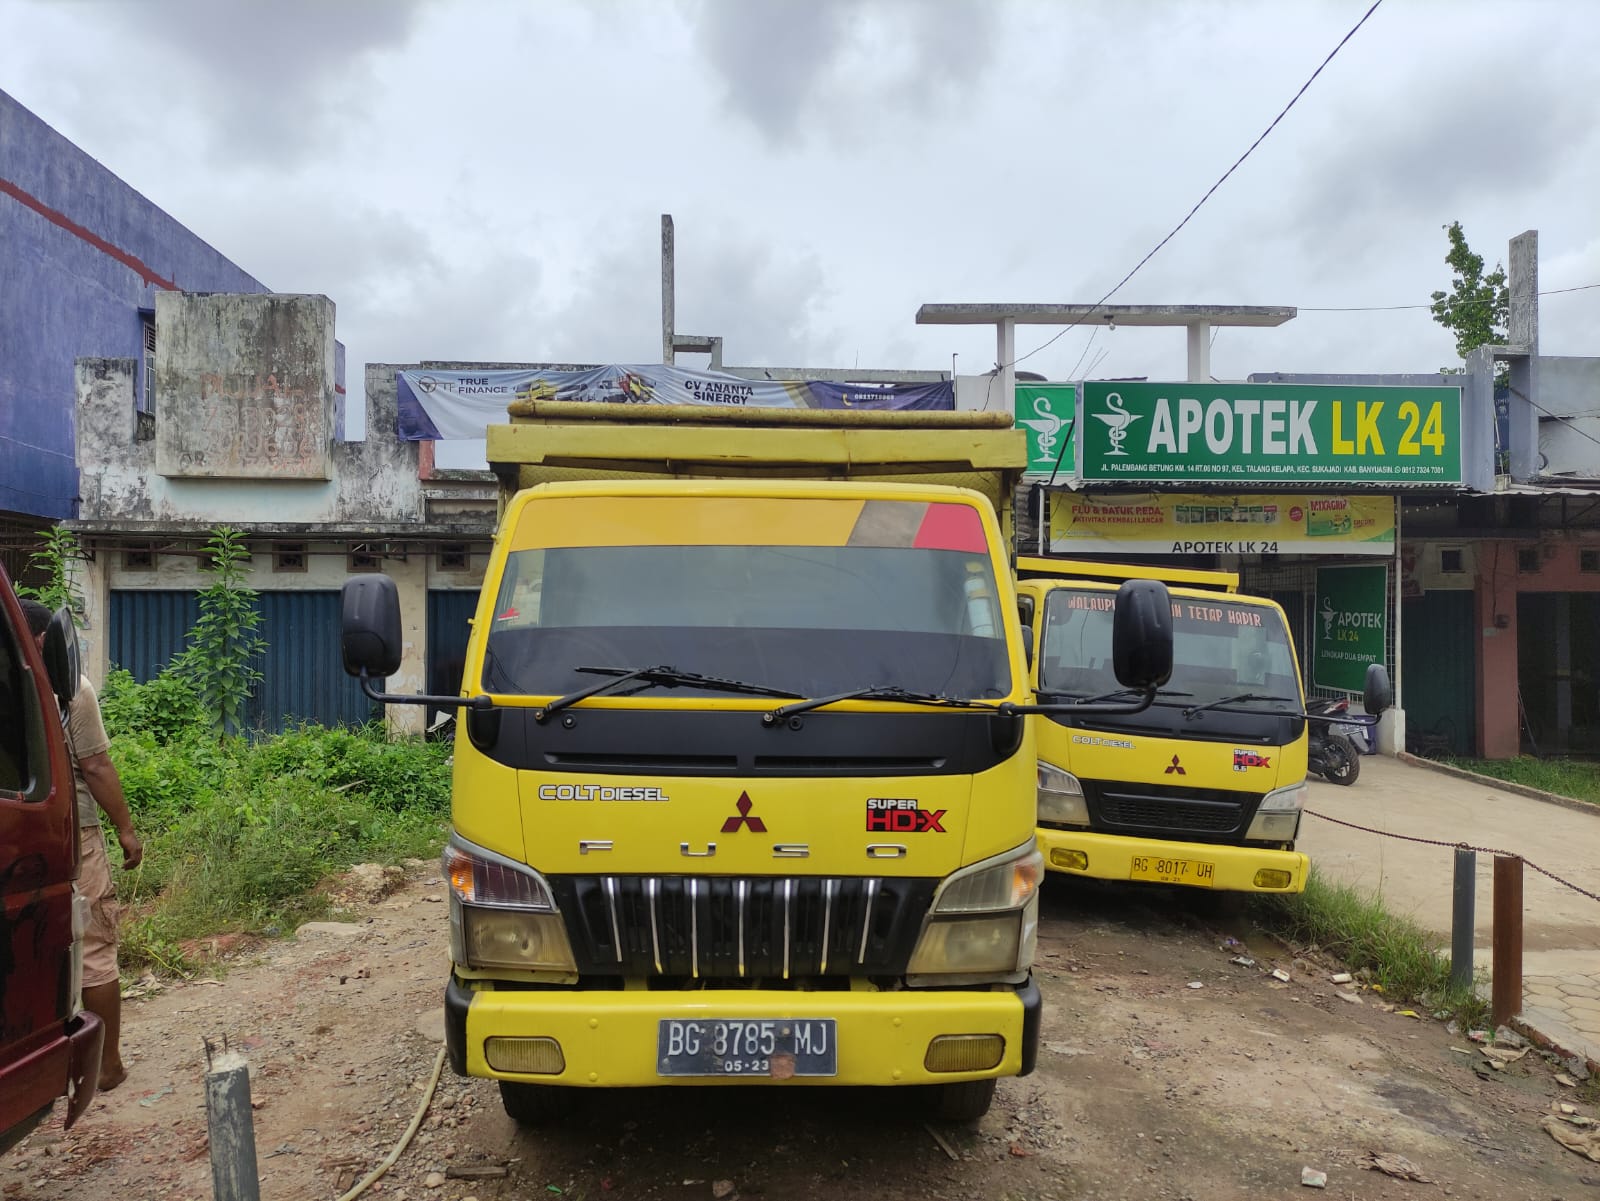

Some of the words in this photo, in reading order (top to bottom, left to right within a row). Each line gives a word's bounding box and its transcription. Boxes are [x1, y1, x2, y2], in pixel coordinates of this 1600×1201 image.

[458, 386, 508, 395] FINANCE
[684, 380, 702, 390] CV
[705, 382, 753, 396] ANANTA
[693, 391, 748, 405] SINERGY
[1147, 398, 1319, 455] APOTEK
[1332, 400, 1385, 455] LK
[1397, 400, 1445, 455] 24
[1111, 463, 1148, 472] PALEMBANG
[1149, 464, 1174, 472] BETUNG
[1246, 465, 1270, 473] TALANG
[1311, 465, 1342, 473] SUKAJADI
[1072, 506, 1090, 514] FLU
[1103, 507, 1134, 515] BATUK
[1172, 542, 1233, 552] APOTEK
[1239, 542, 1256, 552] LK
[1261, 542, 1278, 552] 24
[1068, 596, 1116, 611] WALAUP
[1188, 605, 1223, 622] TETAP
[1228, 610, 1262, 627] HADIR
[1338, 612, 1382, 628] APOTEK
[1338, 630, 1347, 641] LK
[1349, 631, 1359, 642] 24
[1358, 653, 1377, 663] EMPAT
[1072, 735, 1101, 745] COLT
[867, 799, 918, 810] SUPER
[579, 840, 907, 858] FUSO
[1134, 857, 1148, 872] BG
[1157, 860, 1187, 875] 8017
[1197, 863, 1213, 879] UH
[667, 1022, 700, 1057] BG
[713, 1022, 775, 1057] 8785
[794, 1022, 828, 1056] MJ
